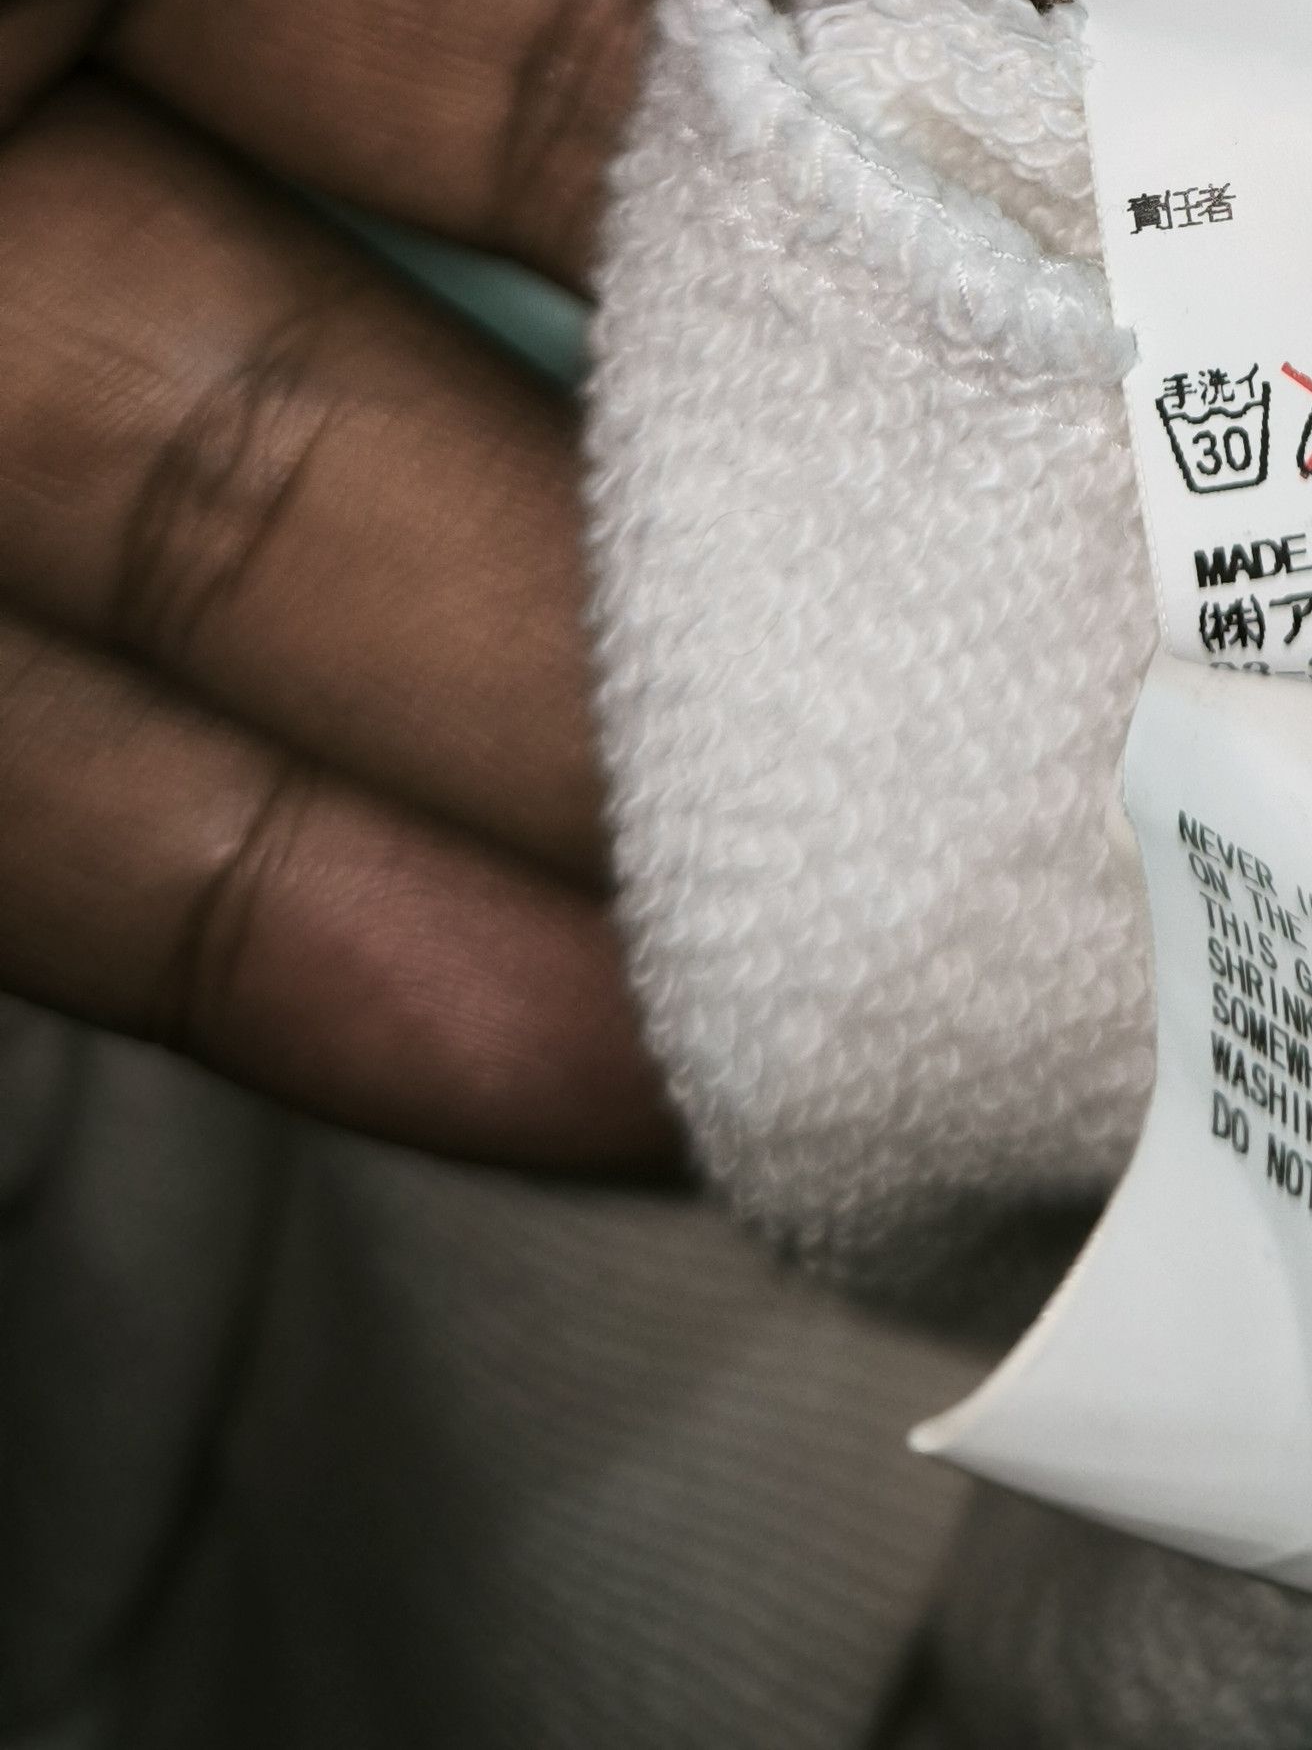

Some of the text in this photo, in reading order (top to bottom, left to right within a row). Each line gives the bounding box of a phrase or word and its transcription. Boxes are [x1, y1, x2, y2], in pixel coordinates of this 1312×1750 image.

[1192, 426, 1252, 475] 30
[1178, 809, 1277, 897] NEVER
[1189, 852, 1231, 901] ON
[1246, 885, 1307, 951] THE
[1200, 891, 1278, 970] THIS
[1212, 1089, 1250, 1154] DO
